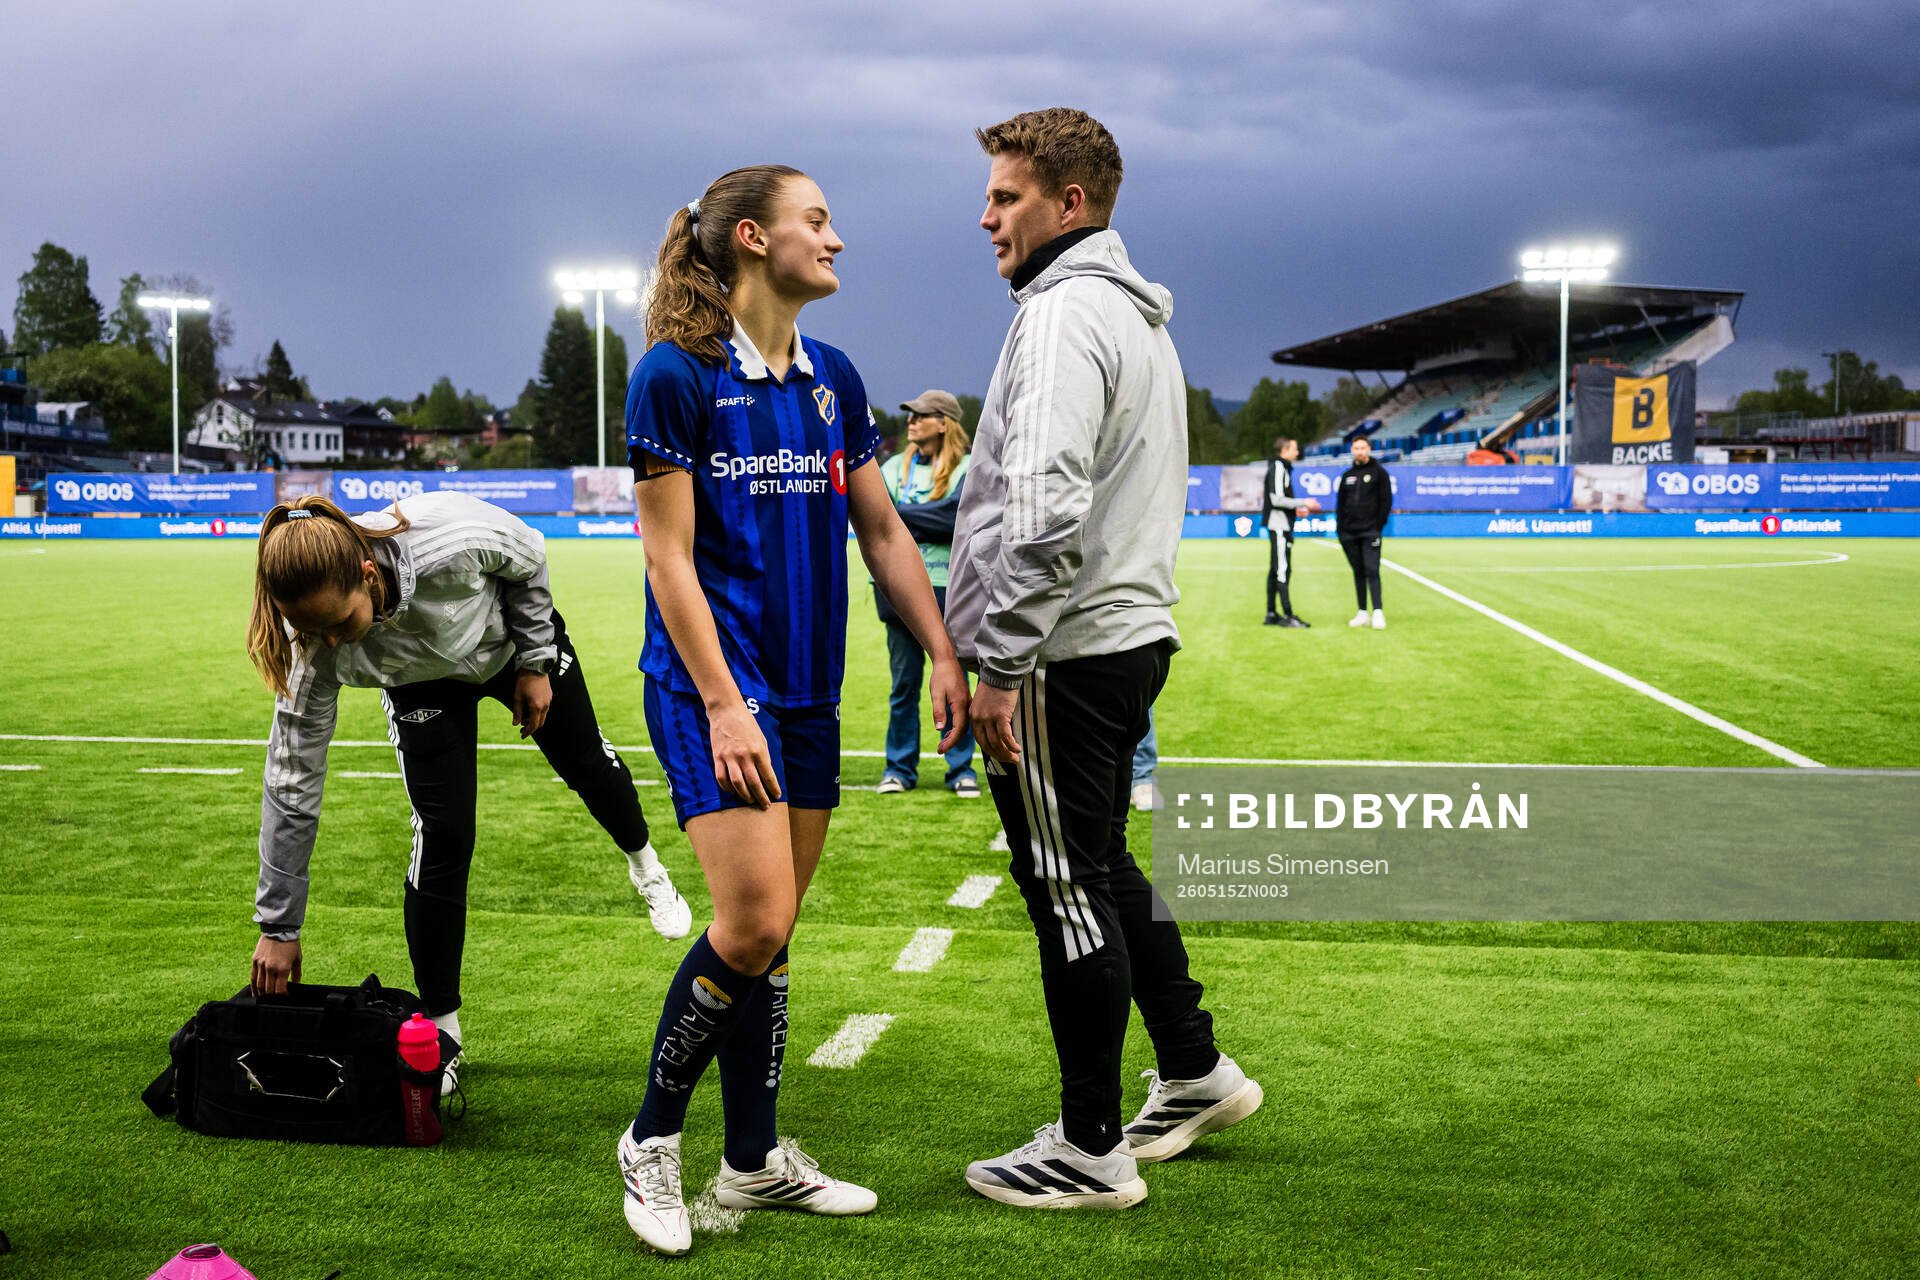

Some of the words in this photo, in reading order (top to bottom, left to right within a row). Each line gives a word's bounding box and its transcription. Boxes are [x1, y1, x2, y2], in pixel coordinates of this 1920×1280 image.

[716, 397, 746, 408] CRAFT
[1632, 387, 1655, 429] B
[1612, 442, 1673, 465] BACKE
[710, 448, 828, 480] SpareBank
[82, 482, 134, 501] OBOS
[749, 480, 828, 495] ØSTLANDET
[1692, 473, 1760, 495] OBOS
[1487, 519, 1529, 533] Alltid.
[1531, 519, 1593, 533] Uansett!
[1695, 518, 1761, 534] SpareBank
[1782, 518, 1842, 532] Østlandet
